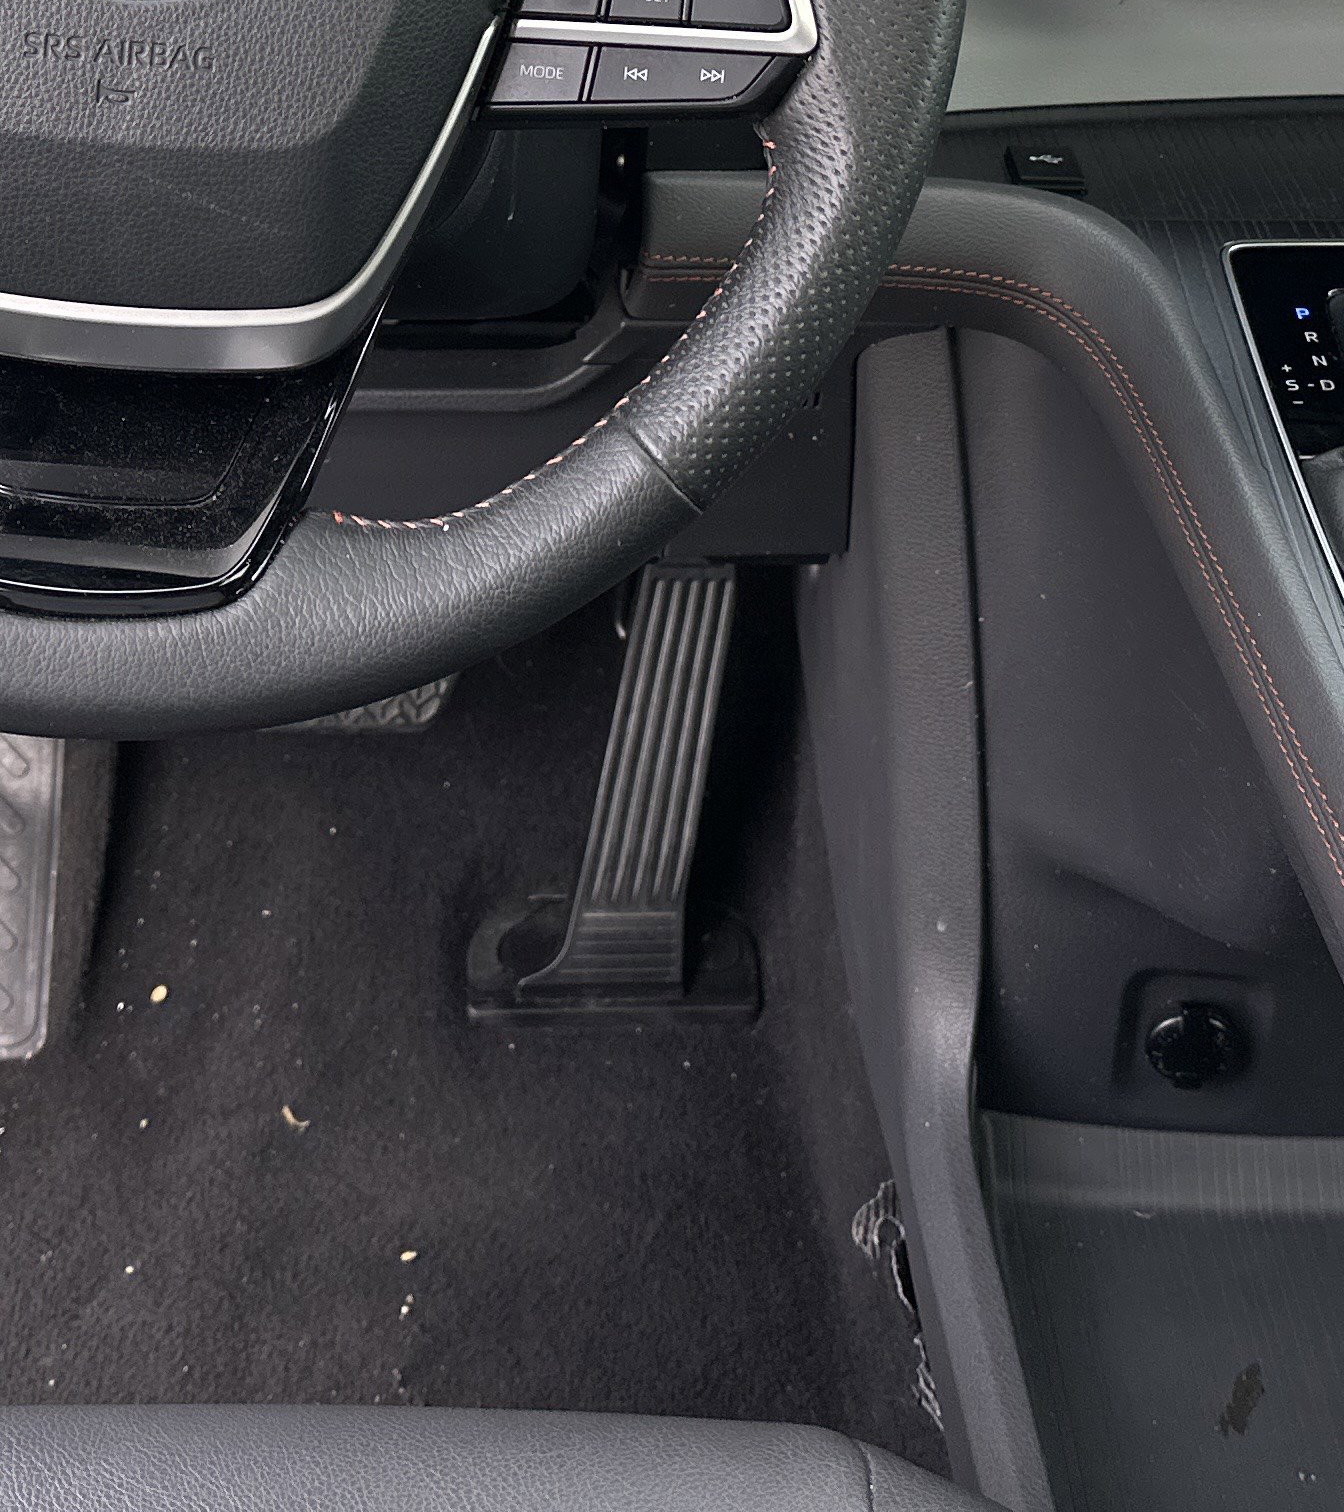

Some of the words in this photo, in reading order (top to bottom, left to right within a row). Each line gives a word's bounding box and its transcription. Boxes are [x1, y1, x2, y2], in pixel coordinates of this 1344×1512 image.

[23, 30, 81, 59] SRS
[93, 37, 216, 71] AIRBAG
[519, 64, 564, 79] MODE
[1296, 308, 1309, 319] P
[1304, 332, 1319, 343] R
[1312, 355, 1328, 367] N
[1285, 379, 1300, 391] S
[1320, 379, 1335, 391] D
